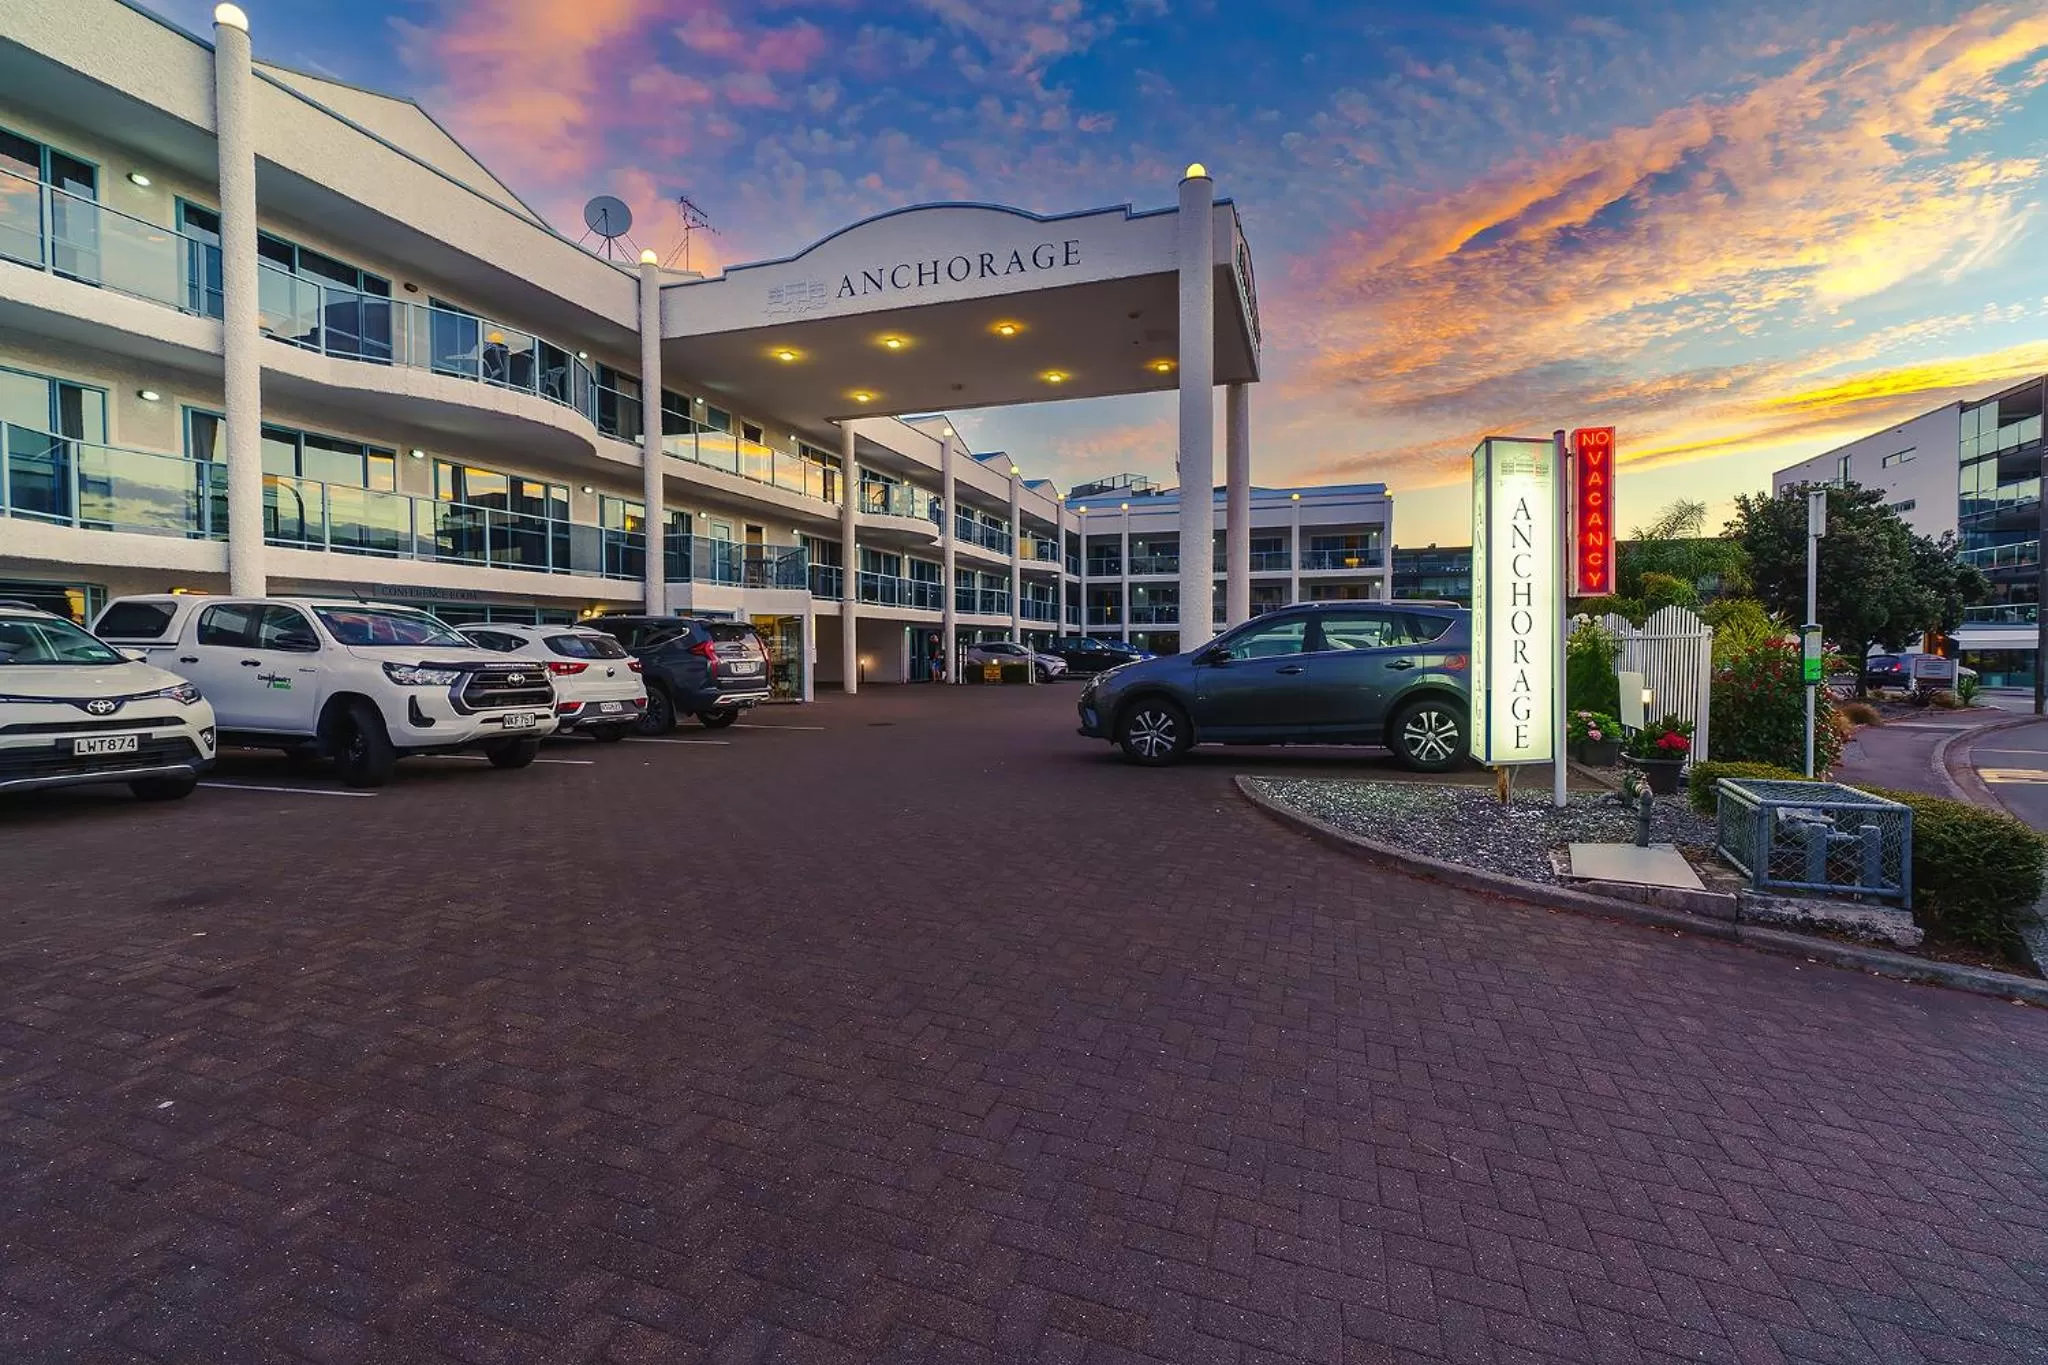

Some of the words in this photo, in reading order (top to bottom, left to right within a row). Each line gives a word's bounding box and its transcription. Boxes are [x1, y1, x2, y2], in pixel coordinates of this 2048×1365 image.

[836, 239, 1081, 298] ANCHORAGE
[1582, 432, 1609, 446] NO
[1588, 451, 1603, 587] VACANCY
[1511, 497, 1532, 749] ANCHORAGE
[77, 738, 135, 753] LWT874
